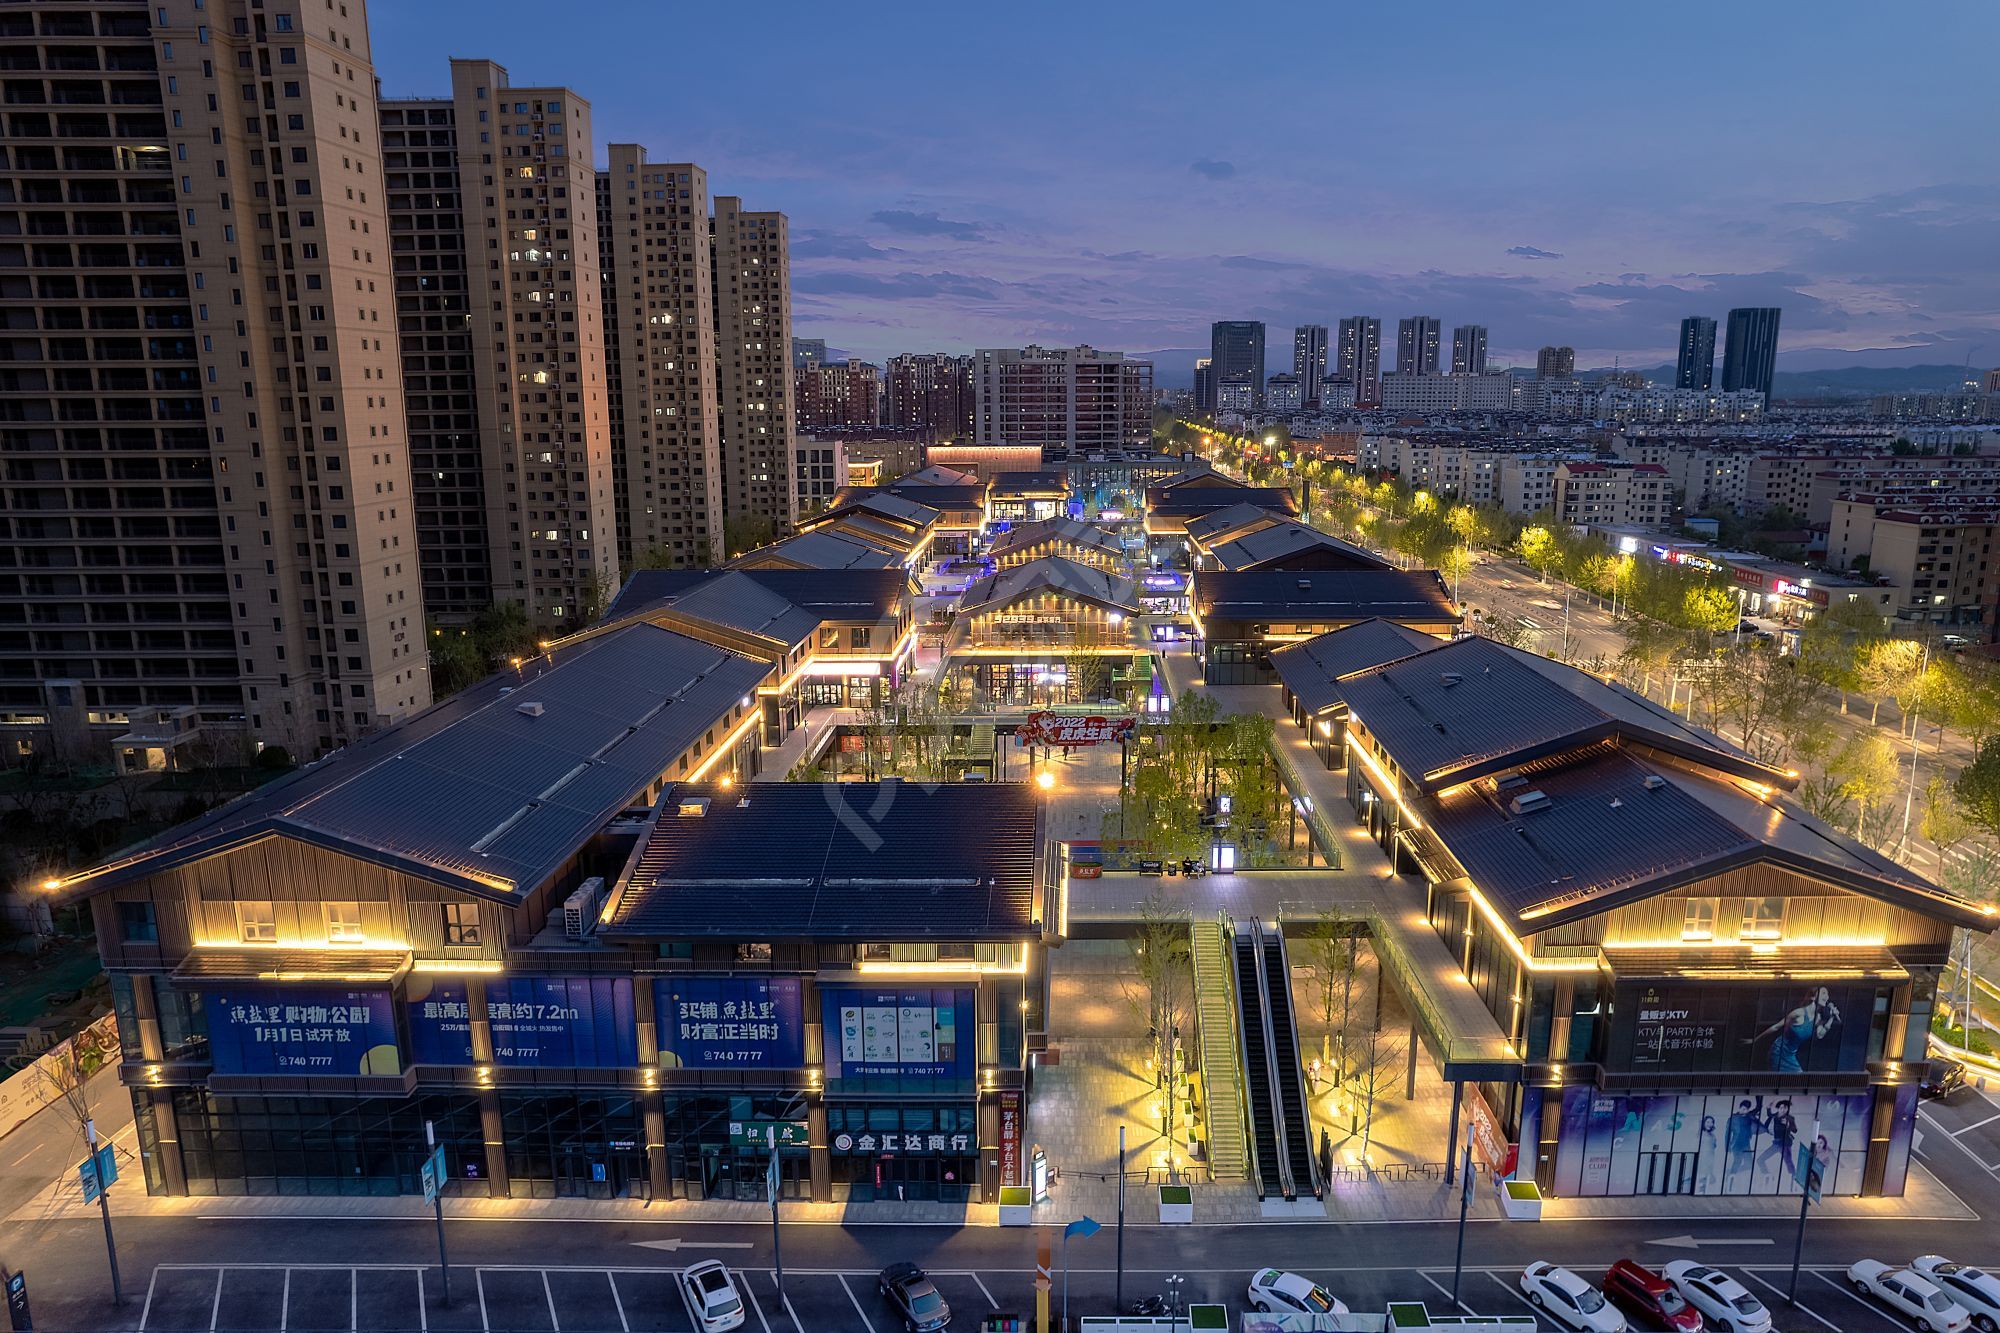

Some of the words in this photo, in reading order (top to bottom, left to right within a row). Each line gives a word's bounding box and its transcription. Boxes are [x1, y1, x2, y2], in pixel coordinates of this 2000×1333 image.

[1055, 717, 1086, 727] 2022
[1058, 727, 1113, 740] 虎虎生威
[254, 1027, 352, 1042] 1月1日试开放
[681, 1023, 779, 1040] 财富正当时
[1666, 1027, 1695, 1036] PARTY
[495, 1048, 513, 1057] 740
[517, 1048, 539, 1056] 7777
[713, 1051, 734, 1060] 740
[737, 1051, 762, 1060] 7777
[288, 1056, 306, 1065] 740
[310, 1056, 332, 1065] 7777
[858, 1134, 968, 1150] 金汇达商行
